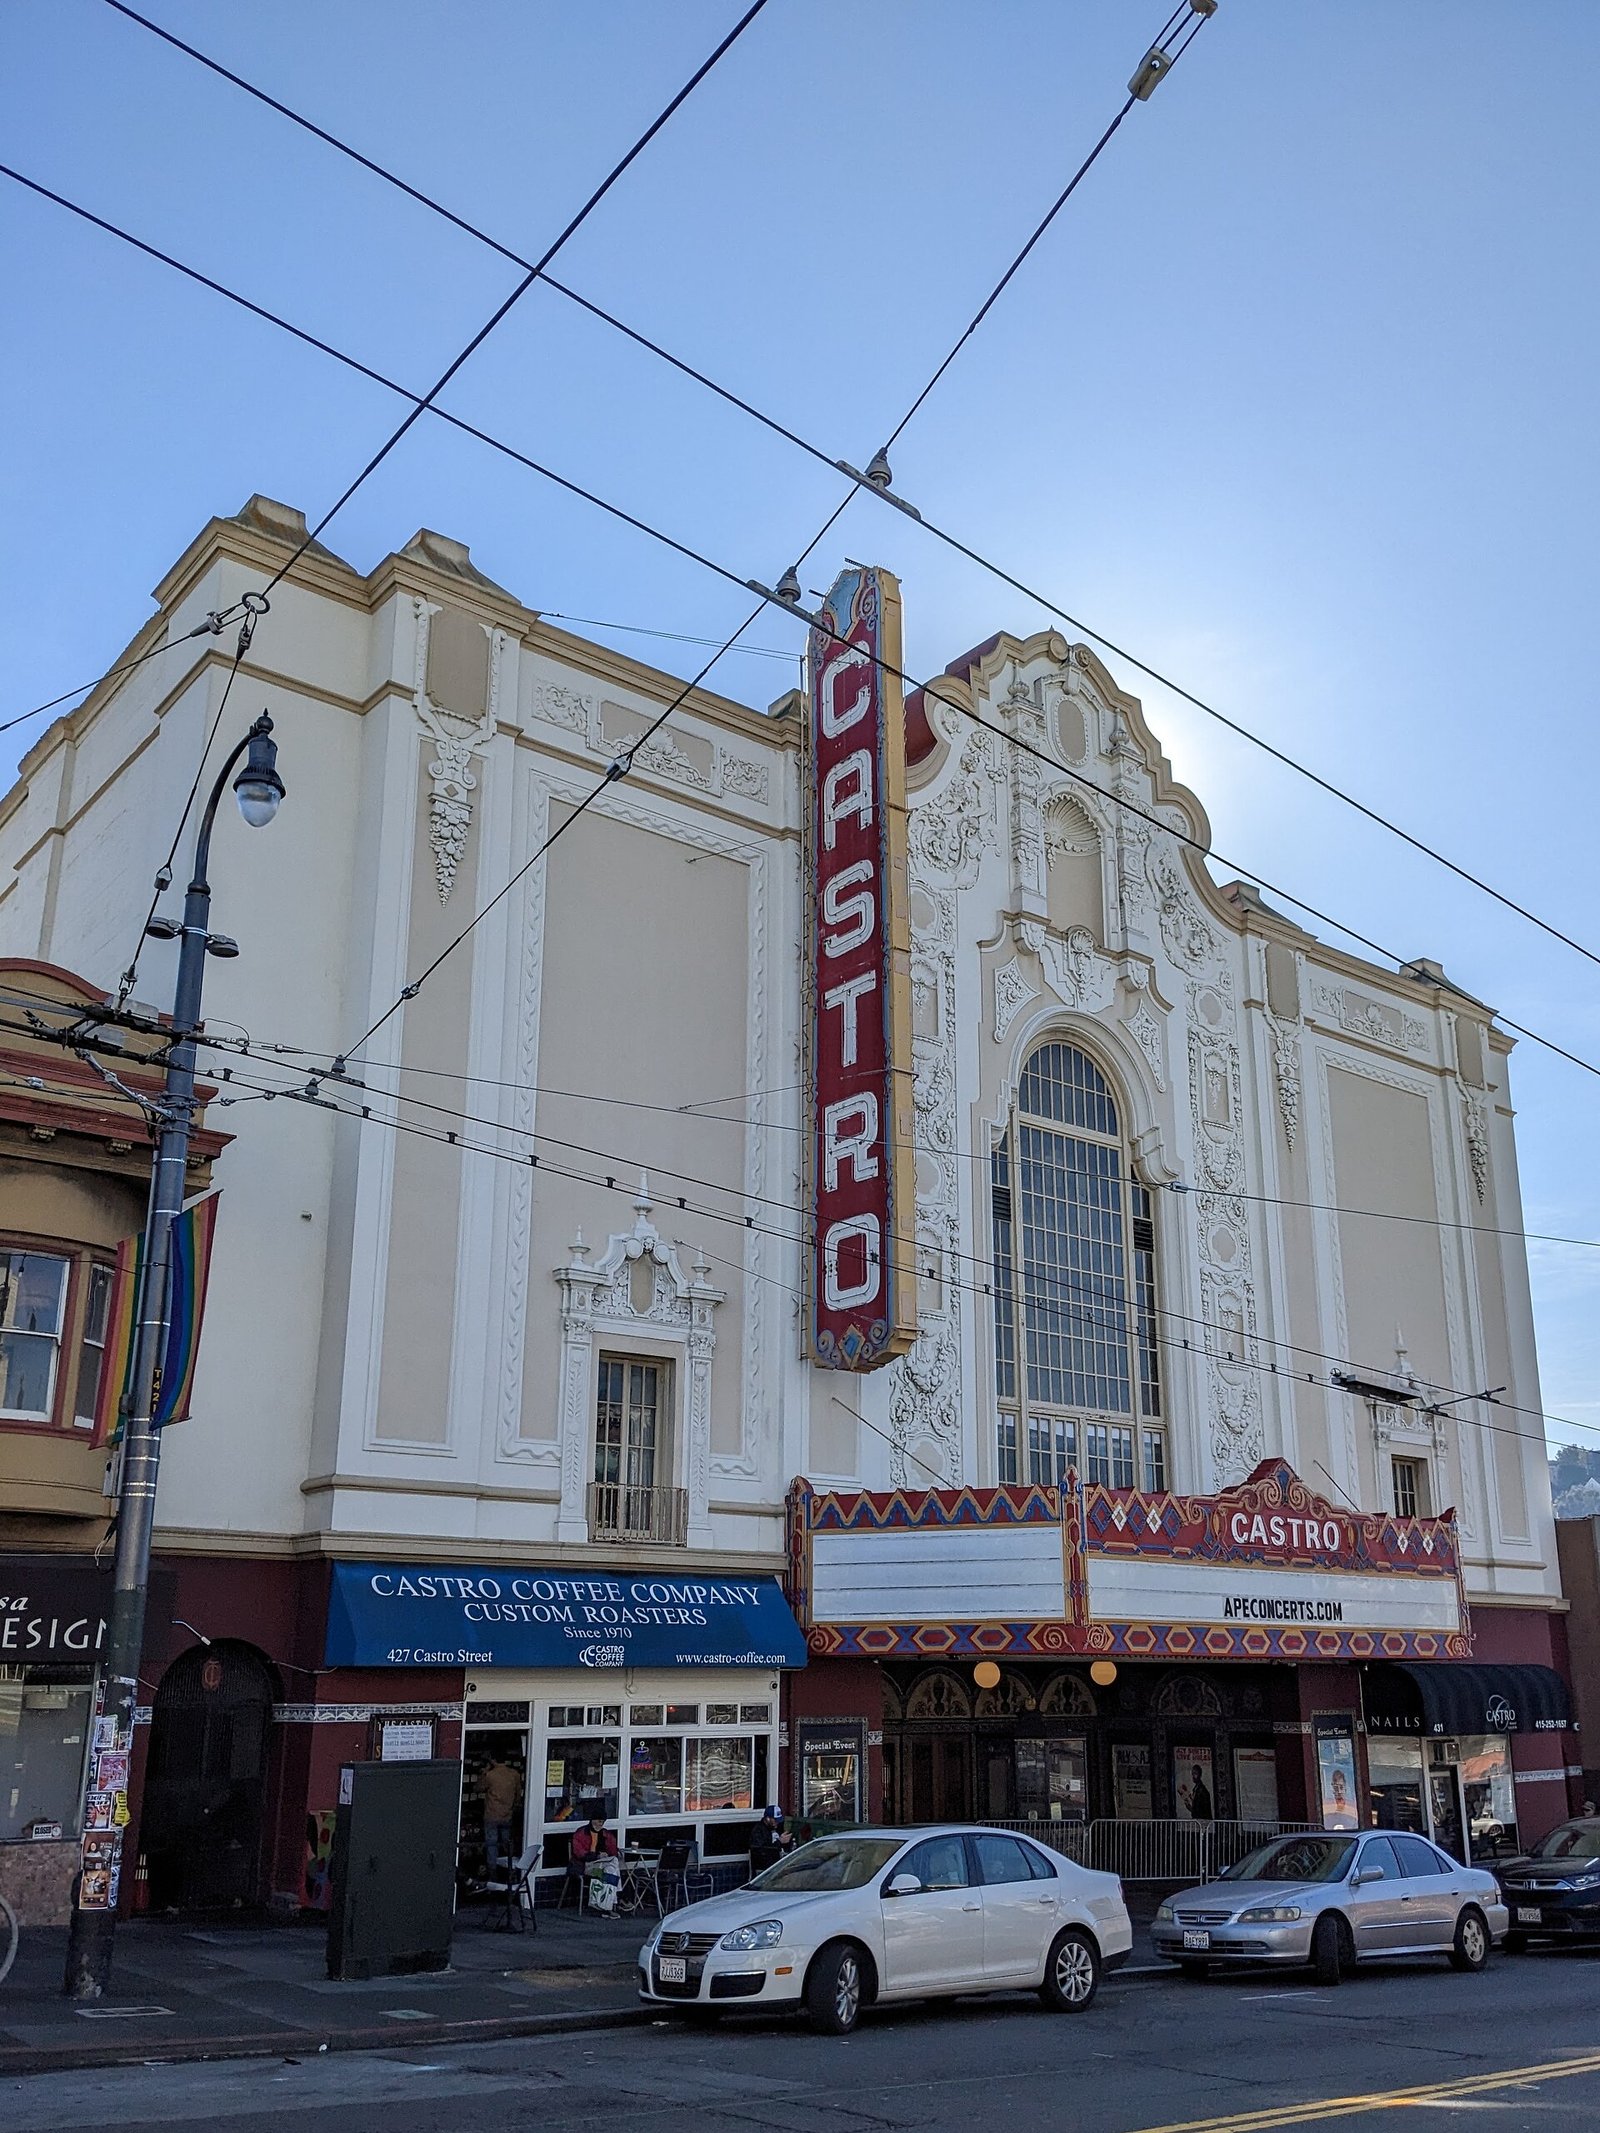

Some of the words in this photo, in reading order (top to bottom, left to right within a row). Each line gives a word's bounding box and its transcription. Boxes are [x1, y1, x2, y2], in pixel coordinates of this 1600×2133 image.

[820, 640, 882, 1313] CASTRO
[1230, 1512, 1340, 1551] CASTRO
[371, 1574, 501, 1599] CASTRO
[511, 1579, 625, 1602] COFFEE
[630, 1583, 761, 1606] COMPANY
[464, 1603, 576, 1624] CUSTOM
[581, 1606, 707, 1625] ROASTERS
[1223, 1597, 1343, 1622] APECONCERTS.COM
[563, 1626, 601, 1638] Since
[603, 1627, 633, 1639] 1970
[595, 1645, 625, 1653] CASTRO
[387, 1649, 410, 1662] 427
[413, 1649, 454, 1663] Castro
[457, 1649, 493, 1663] Street
[595, 1653, 625, 1661] COFFEE
[675, 1652, 786, 1665] www.castro-coffee.com
[1371, 1716, 1420, 1728] NAILS
[1486, 1709, 1516, 1722] CASTRO
[1433, 1723, 1444, 1733] 431
[804, 1740, 832, 1751] Special
[833, 1740, 855, 1749] Event
